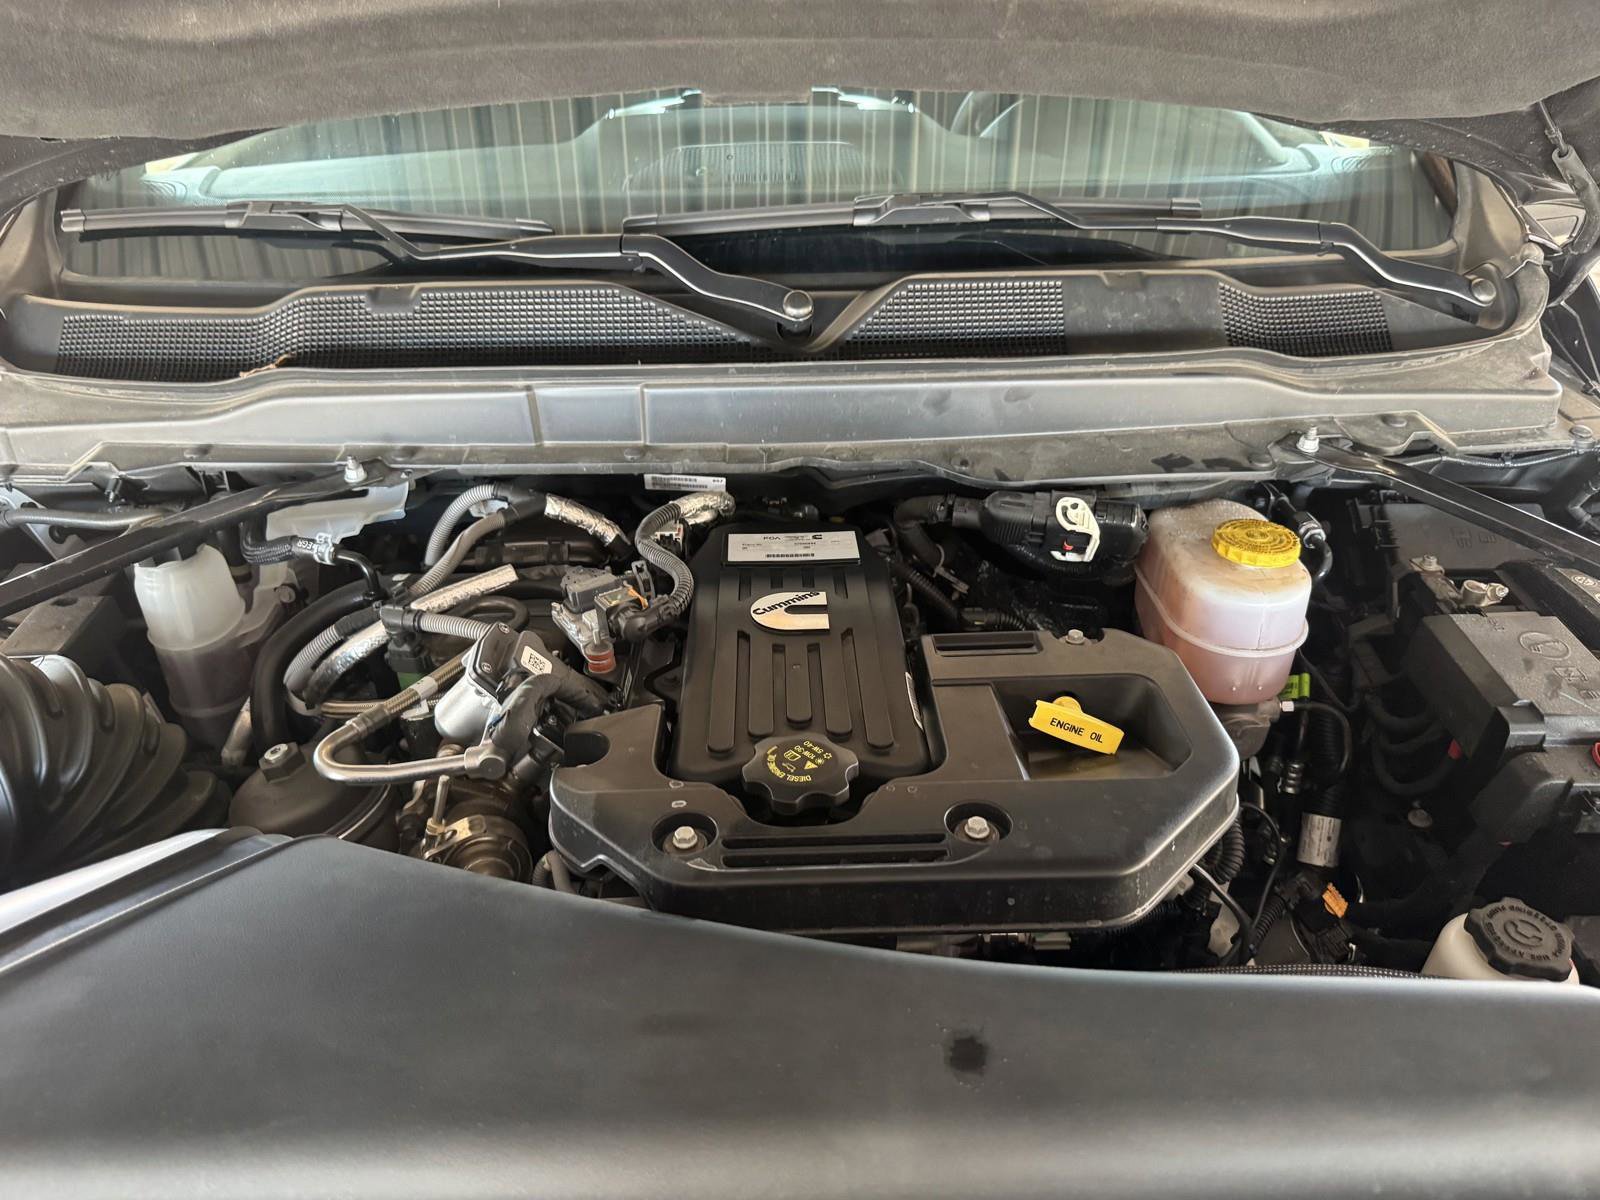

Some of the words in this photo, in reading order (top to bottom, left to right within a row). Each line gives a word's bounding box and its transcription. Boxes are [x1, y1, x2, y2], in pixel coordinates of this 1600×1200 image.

[752, 591, 820, 615] Cummins
[1050, 717, 1085, 736] ENGINE
[1089, 731, 1103, 743] OIL
[803, 740, 824, 754] 5W-40
[786, 774, 812, 782] DIESEL
